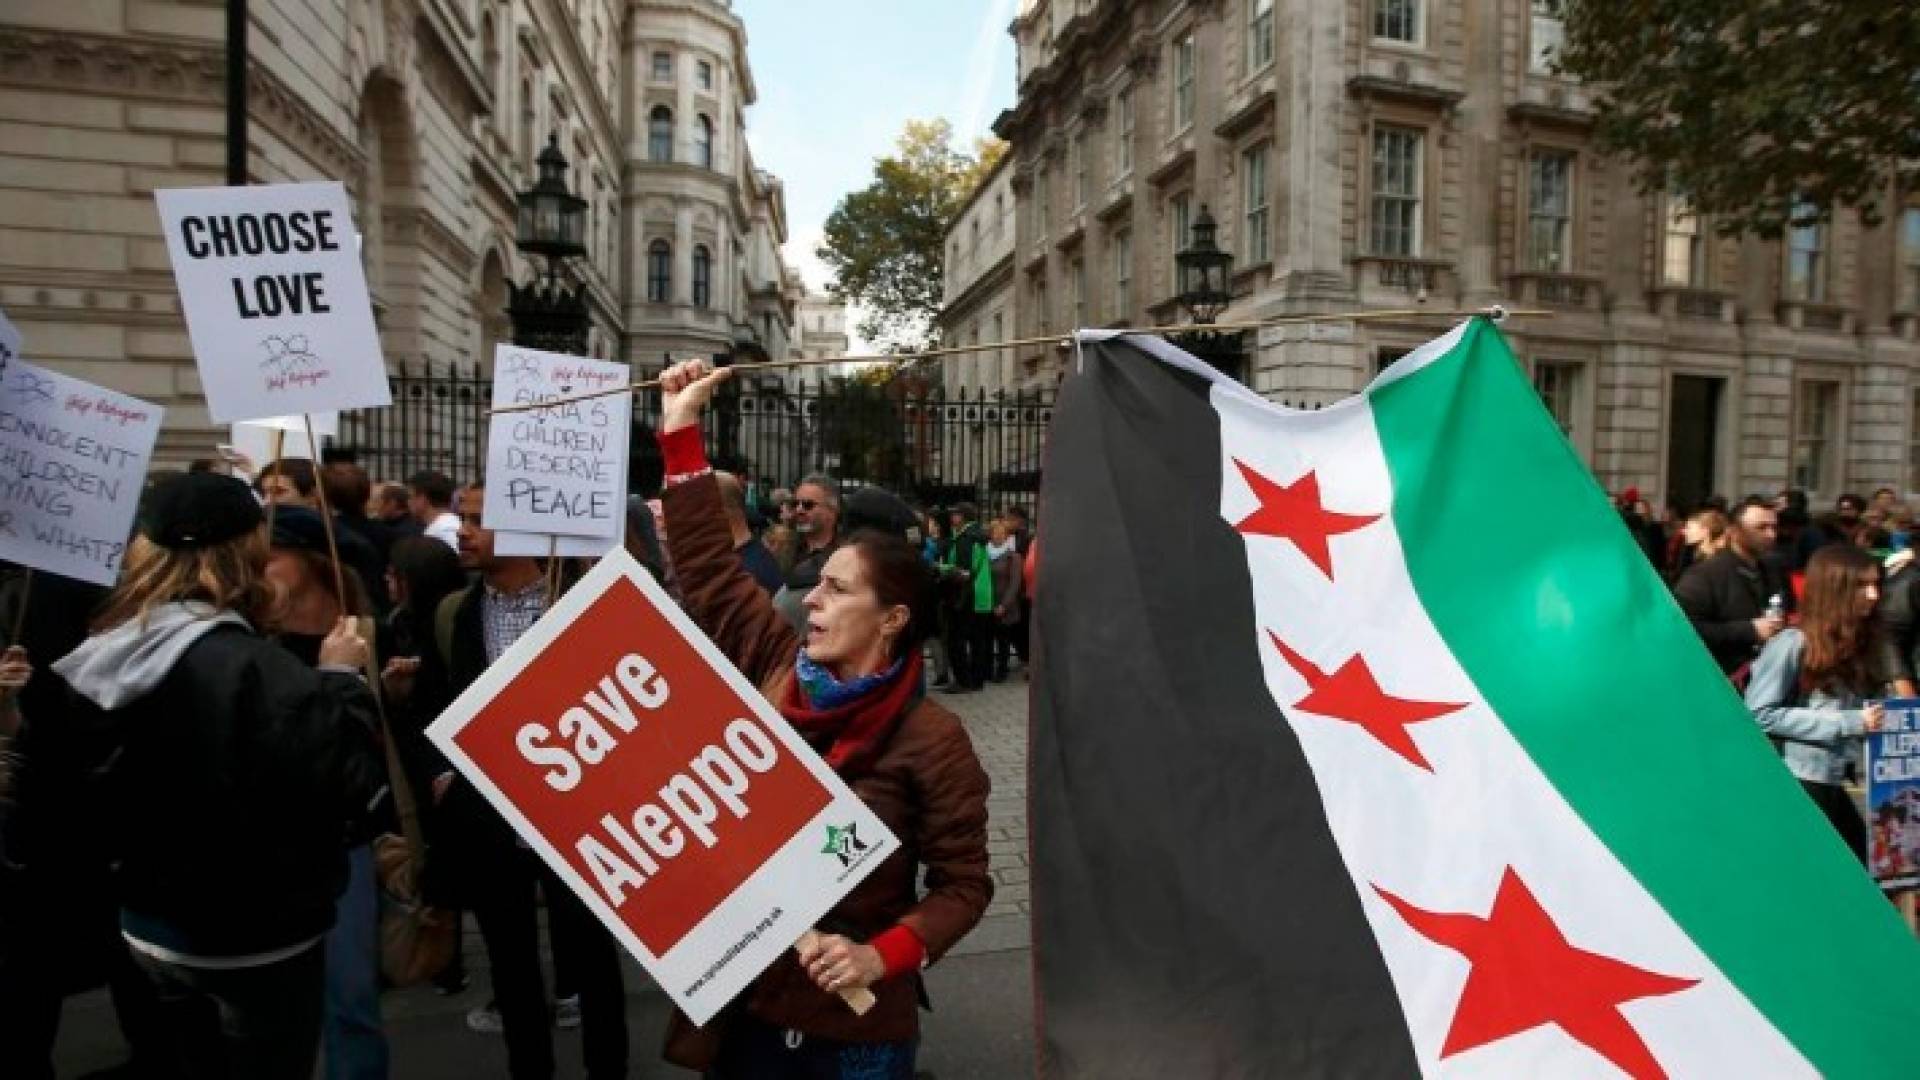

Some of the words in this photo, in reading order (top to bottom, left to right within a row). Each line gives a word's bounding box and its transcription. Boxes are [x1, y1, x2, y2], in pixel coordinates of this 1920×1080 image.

[181, 210, 338, 259] CHOOSE
[232, 272, 330, 319] LOVE
[513, 421, 606, 452] CHILDREN
[506, 446, 615, 482] DESERVE
[505, 477, 612, 519] PEACE
[30, 520, 124, 570] WHAT?
[515, 652, 670, 793] Save
[574, 716, 779, 908] Aleppo
